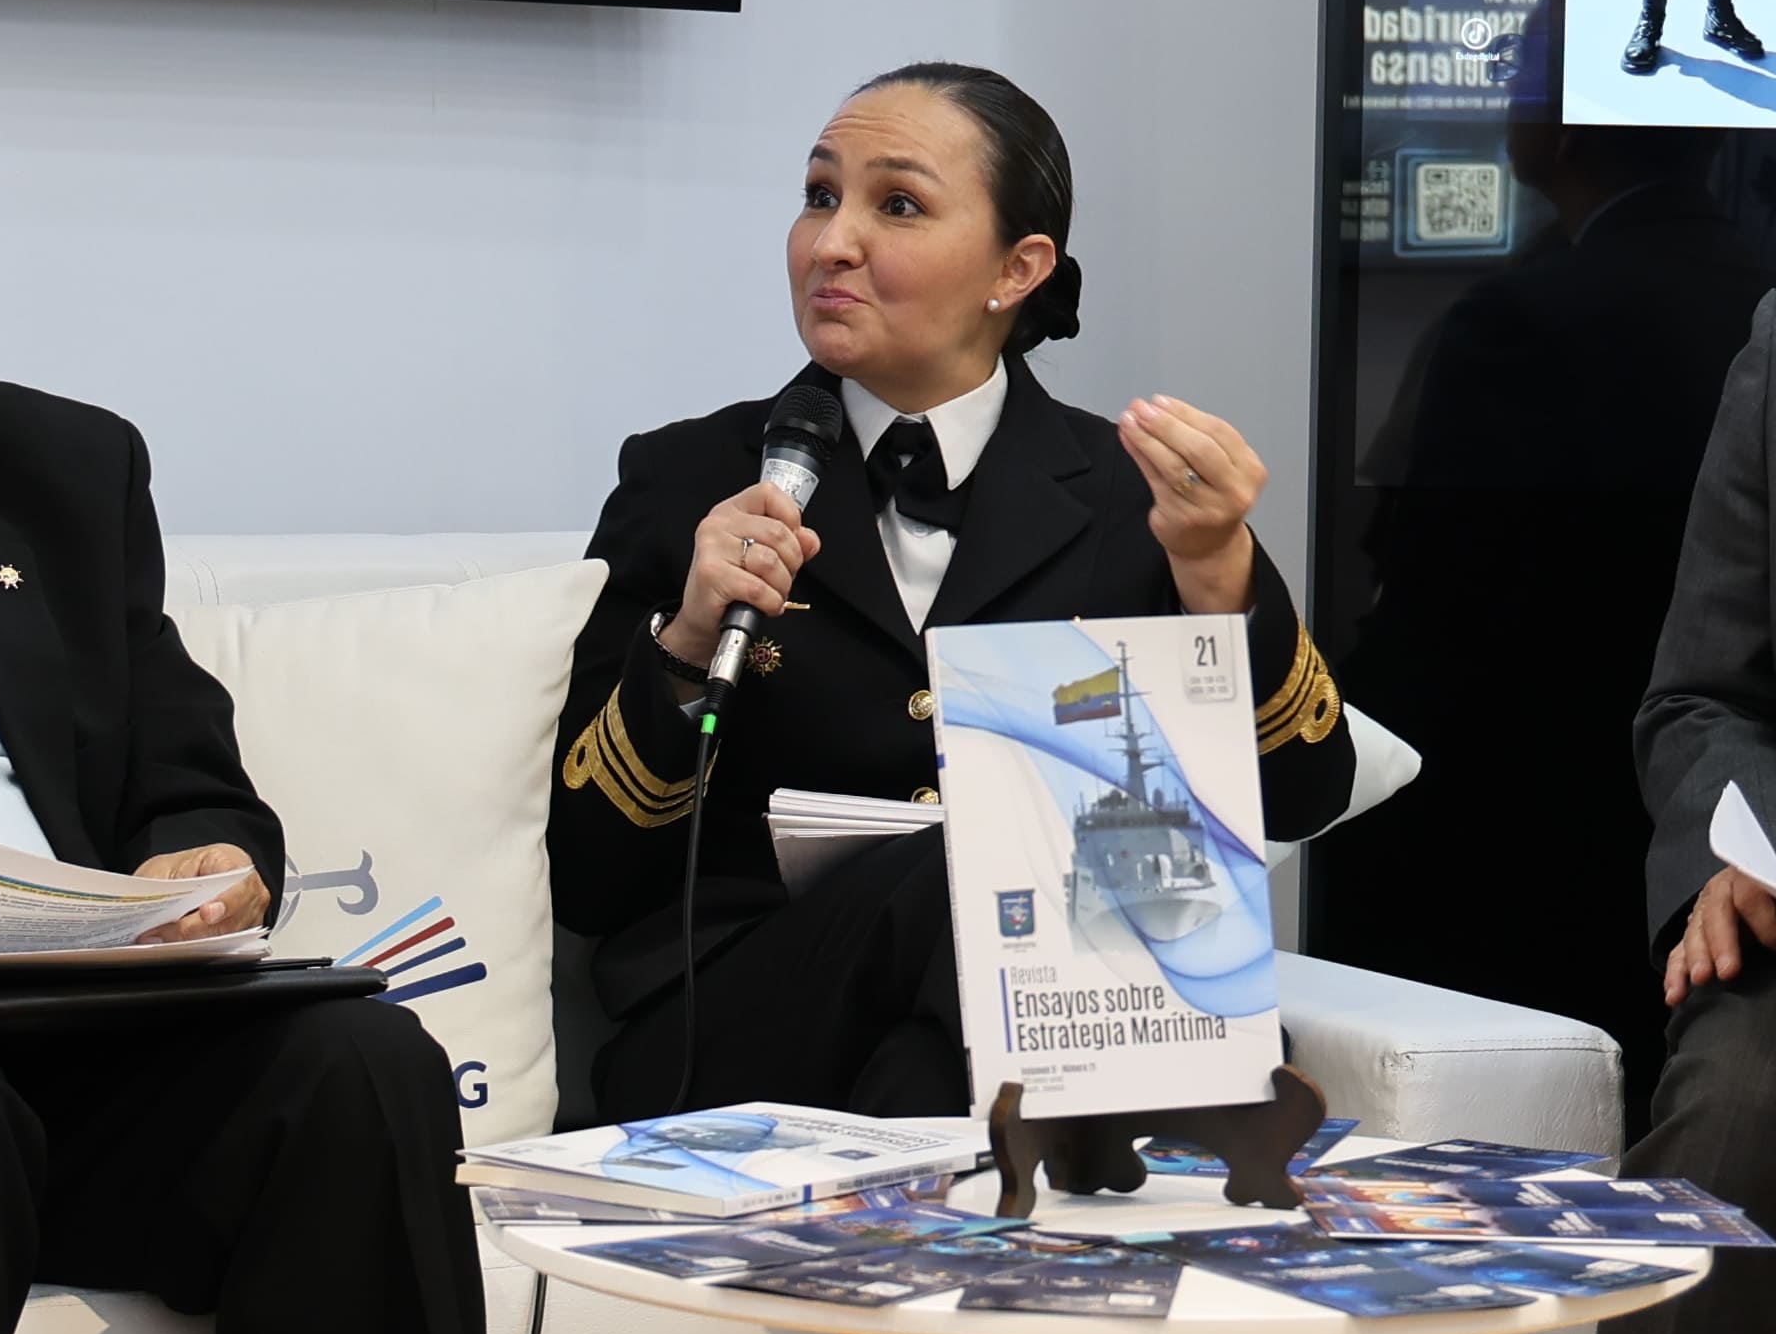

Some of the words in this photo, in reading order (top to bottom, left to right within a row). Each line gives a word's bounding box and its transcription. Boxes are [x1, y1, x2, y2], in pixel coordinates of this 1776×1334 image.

[1194, 635, 1217, 667] 21
[1010, 965, 1057, 985] Revista
[1014, 989, 1100, 1019] Ensayos
[1104, 983, 1165, 1012] sobre
[1016, 1019, 1125, 1052] Estrategia
[1131, 1011, 1226, 1045] Marítima
